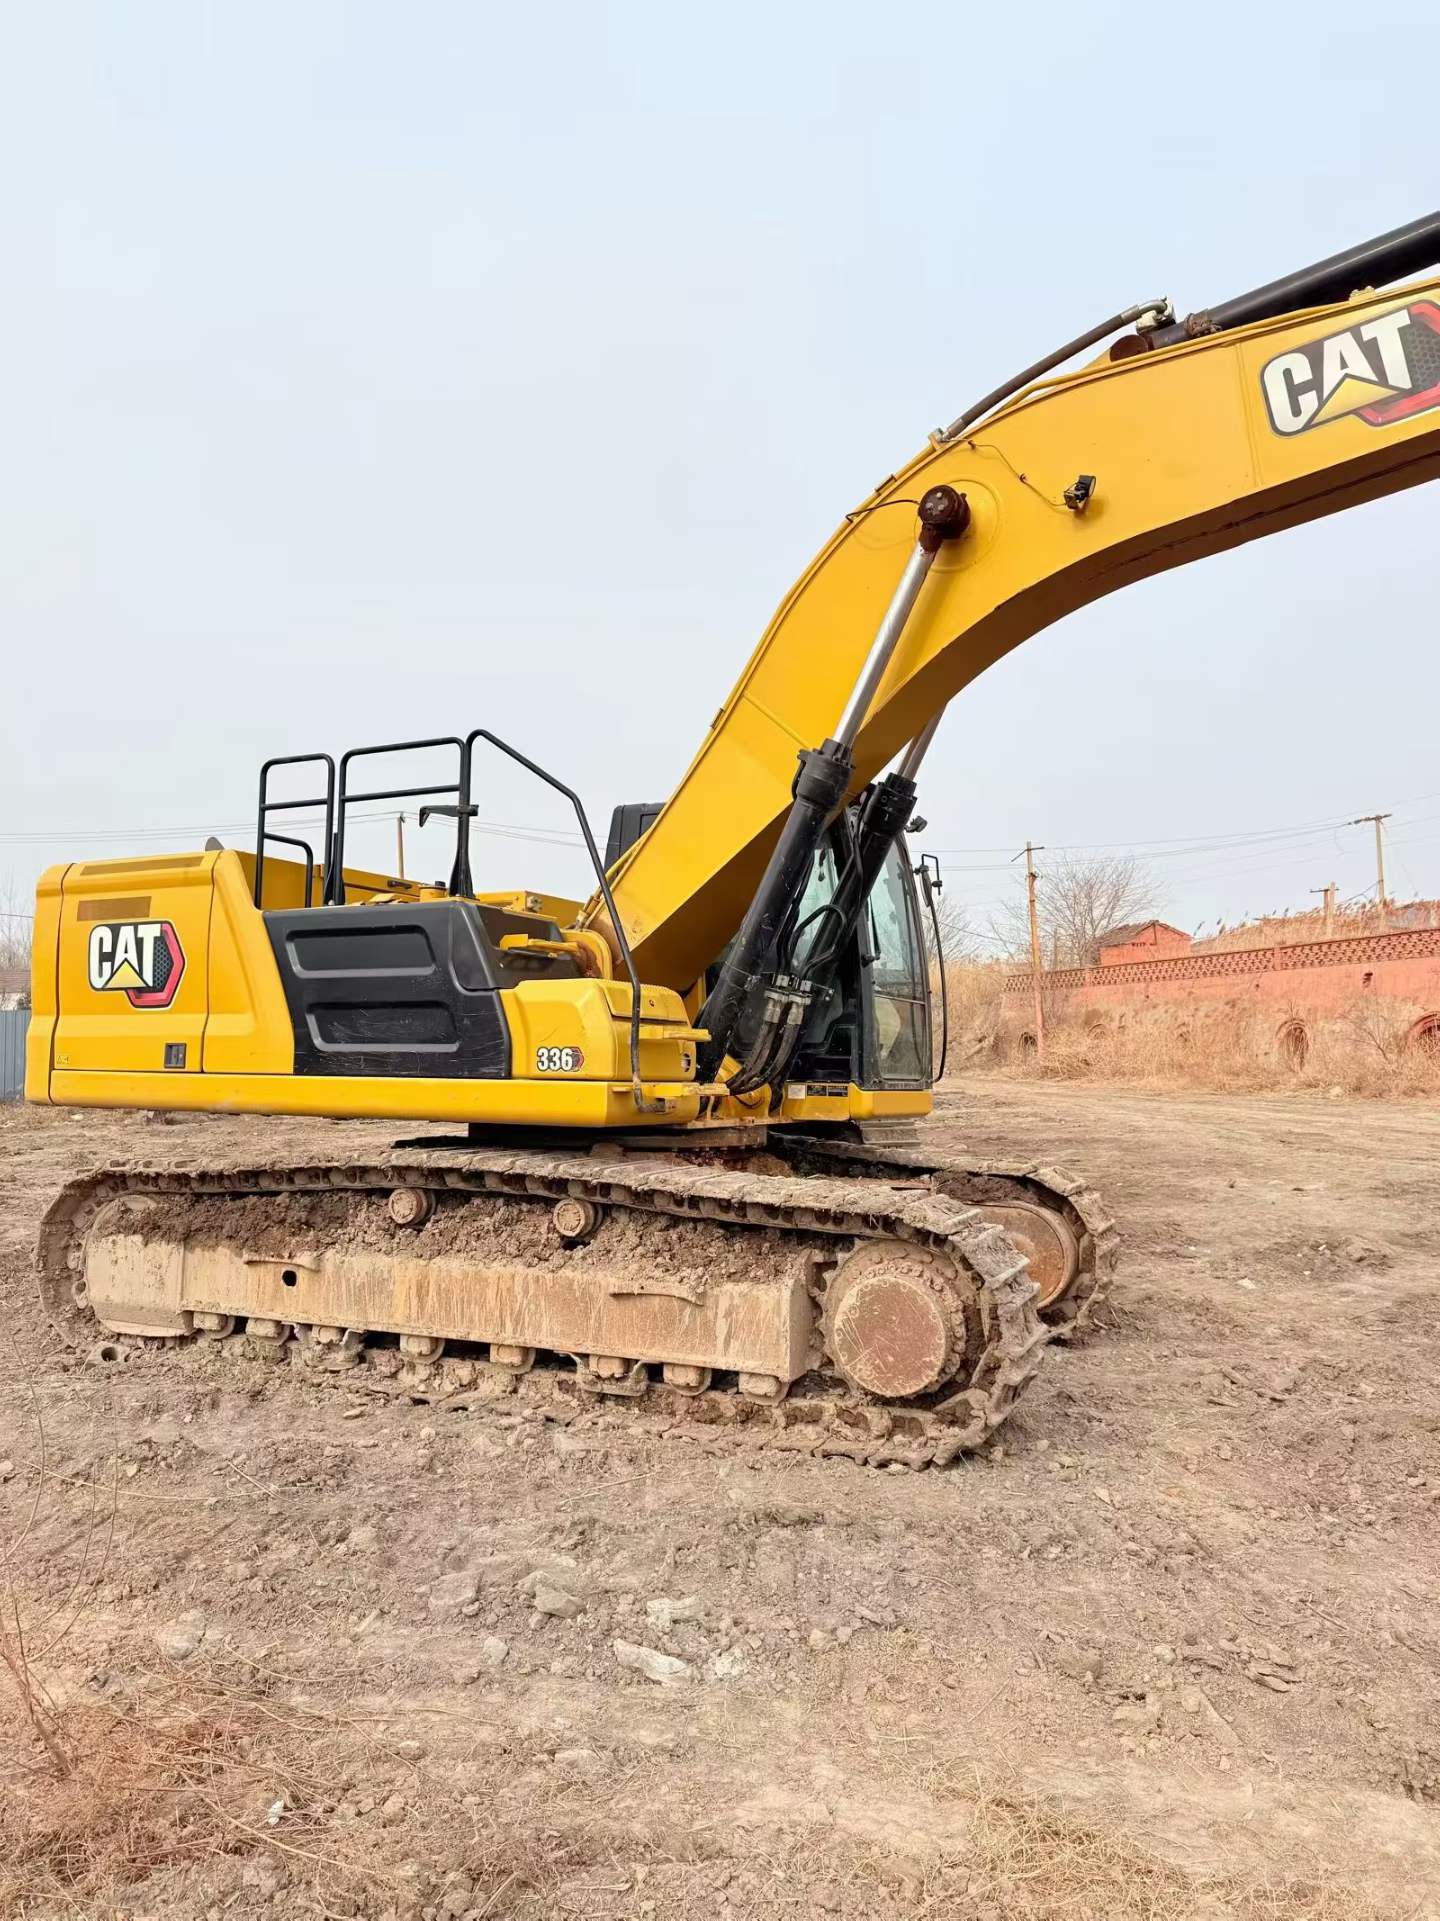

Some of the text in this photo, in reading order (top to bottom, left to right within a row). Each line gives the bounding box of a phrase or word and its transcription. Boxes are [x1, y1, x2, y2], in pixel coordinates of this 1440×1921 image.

[1263, 309, 1413, 433] CAT
[89, 923, 161, 989] CAT
[537, 1047, 573, 1071] 336
